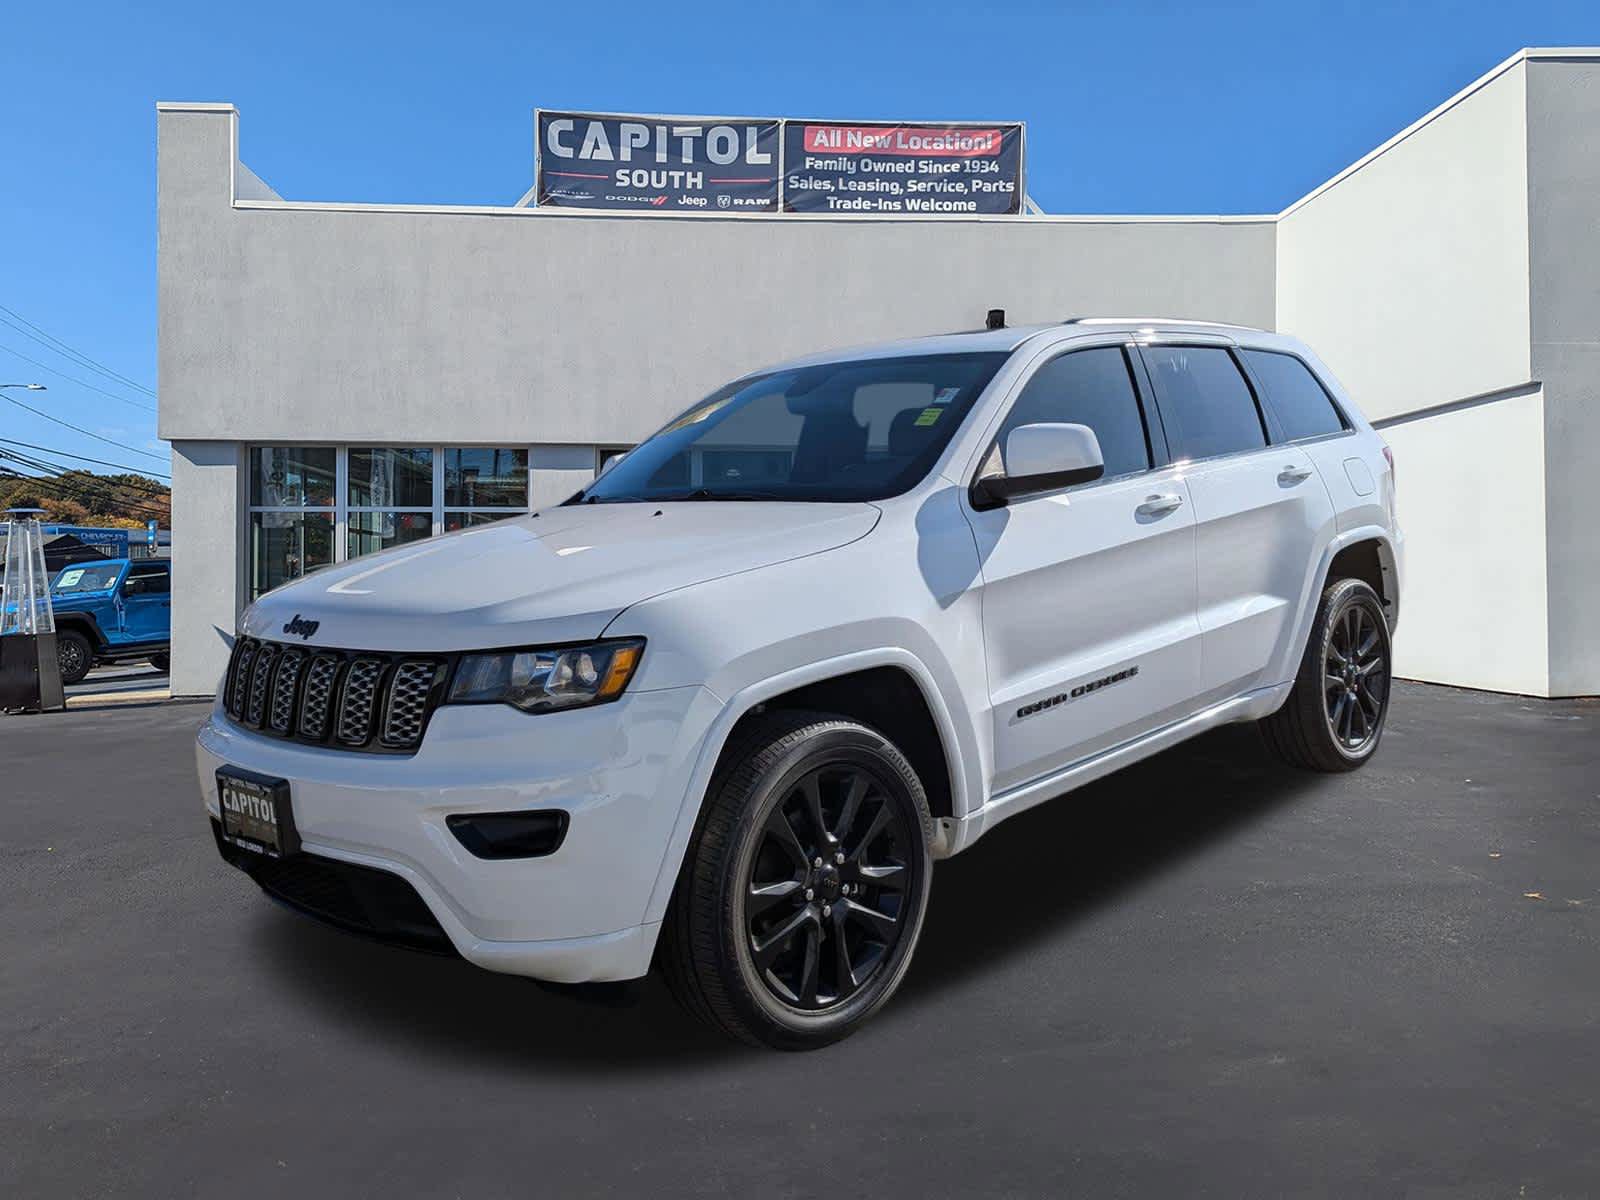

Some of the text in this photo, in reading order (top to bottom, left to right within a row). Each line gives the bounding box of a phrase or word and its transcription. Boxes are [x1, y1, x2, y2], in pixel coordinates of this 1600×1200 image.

[547, 119, 772, 165] CAPITOL
[813, 129, 993, 151] All New Location!
[805, 156, 1000, 174] Family Owned Since 1934
[615, 168, 703, 189] SOUTH
[788, 176, 1015, 195] Sales, Leasing, Service, Parts
[678, 195, 708, 207] Jeep
[733, 198, 771, 206] RAM
[827, 196, 977, 211] Trade-Ins Welcome
[283, 614, 320, 640] Jeep
[222, 788, 277, 825] CAPITOL
